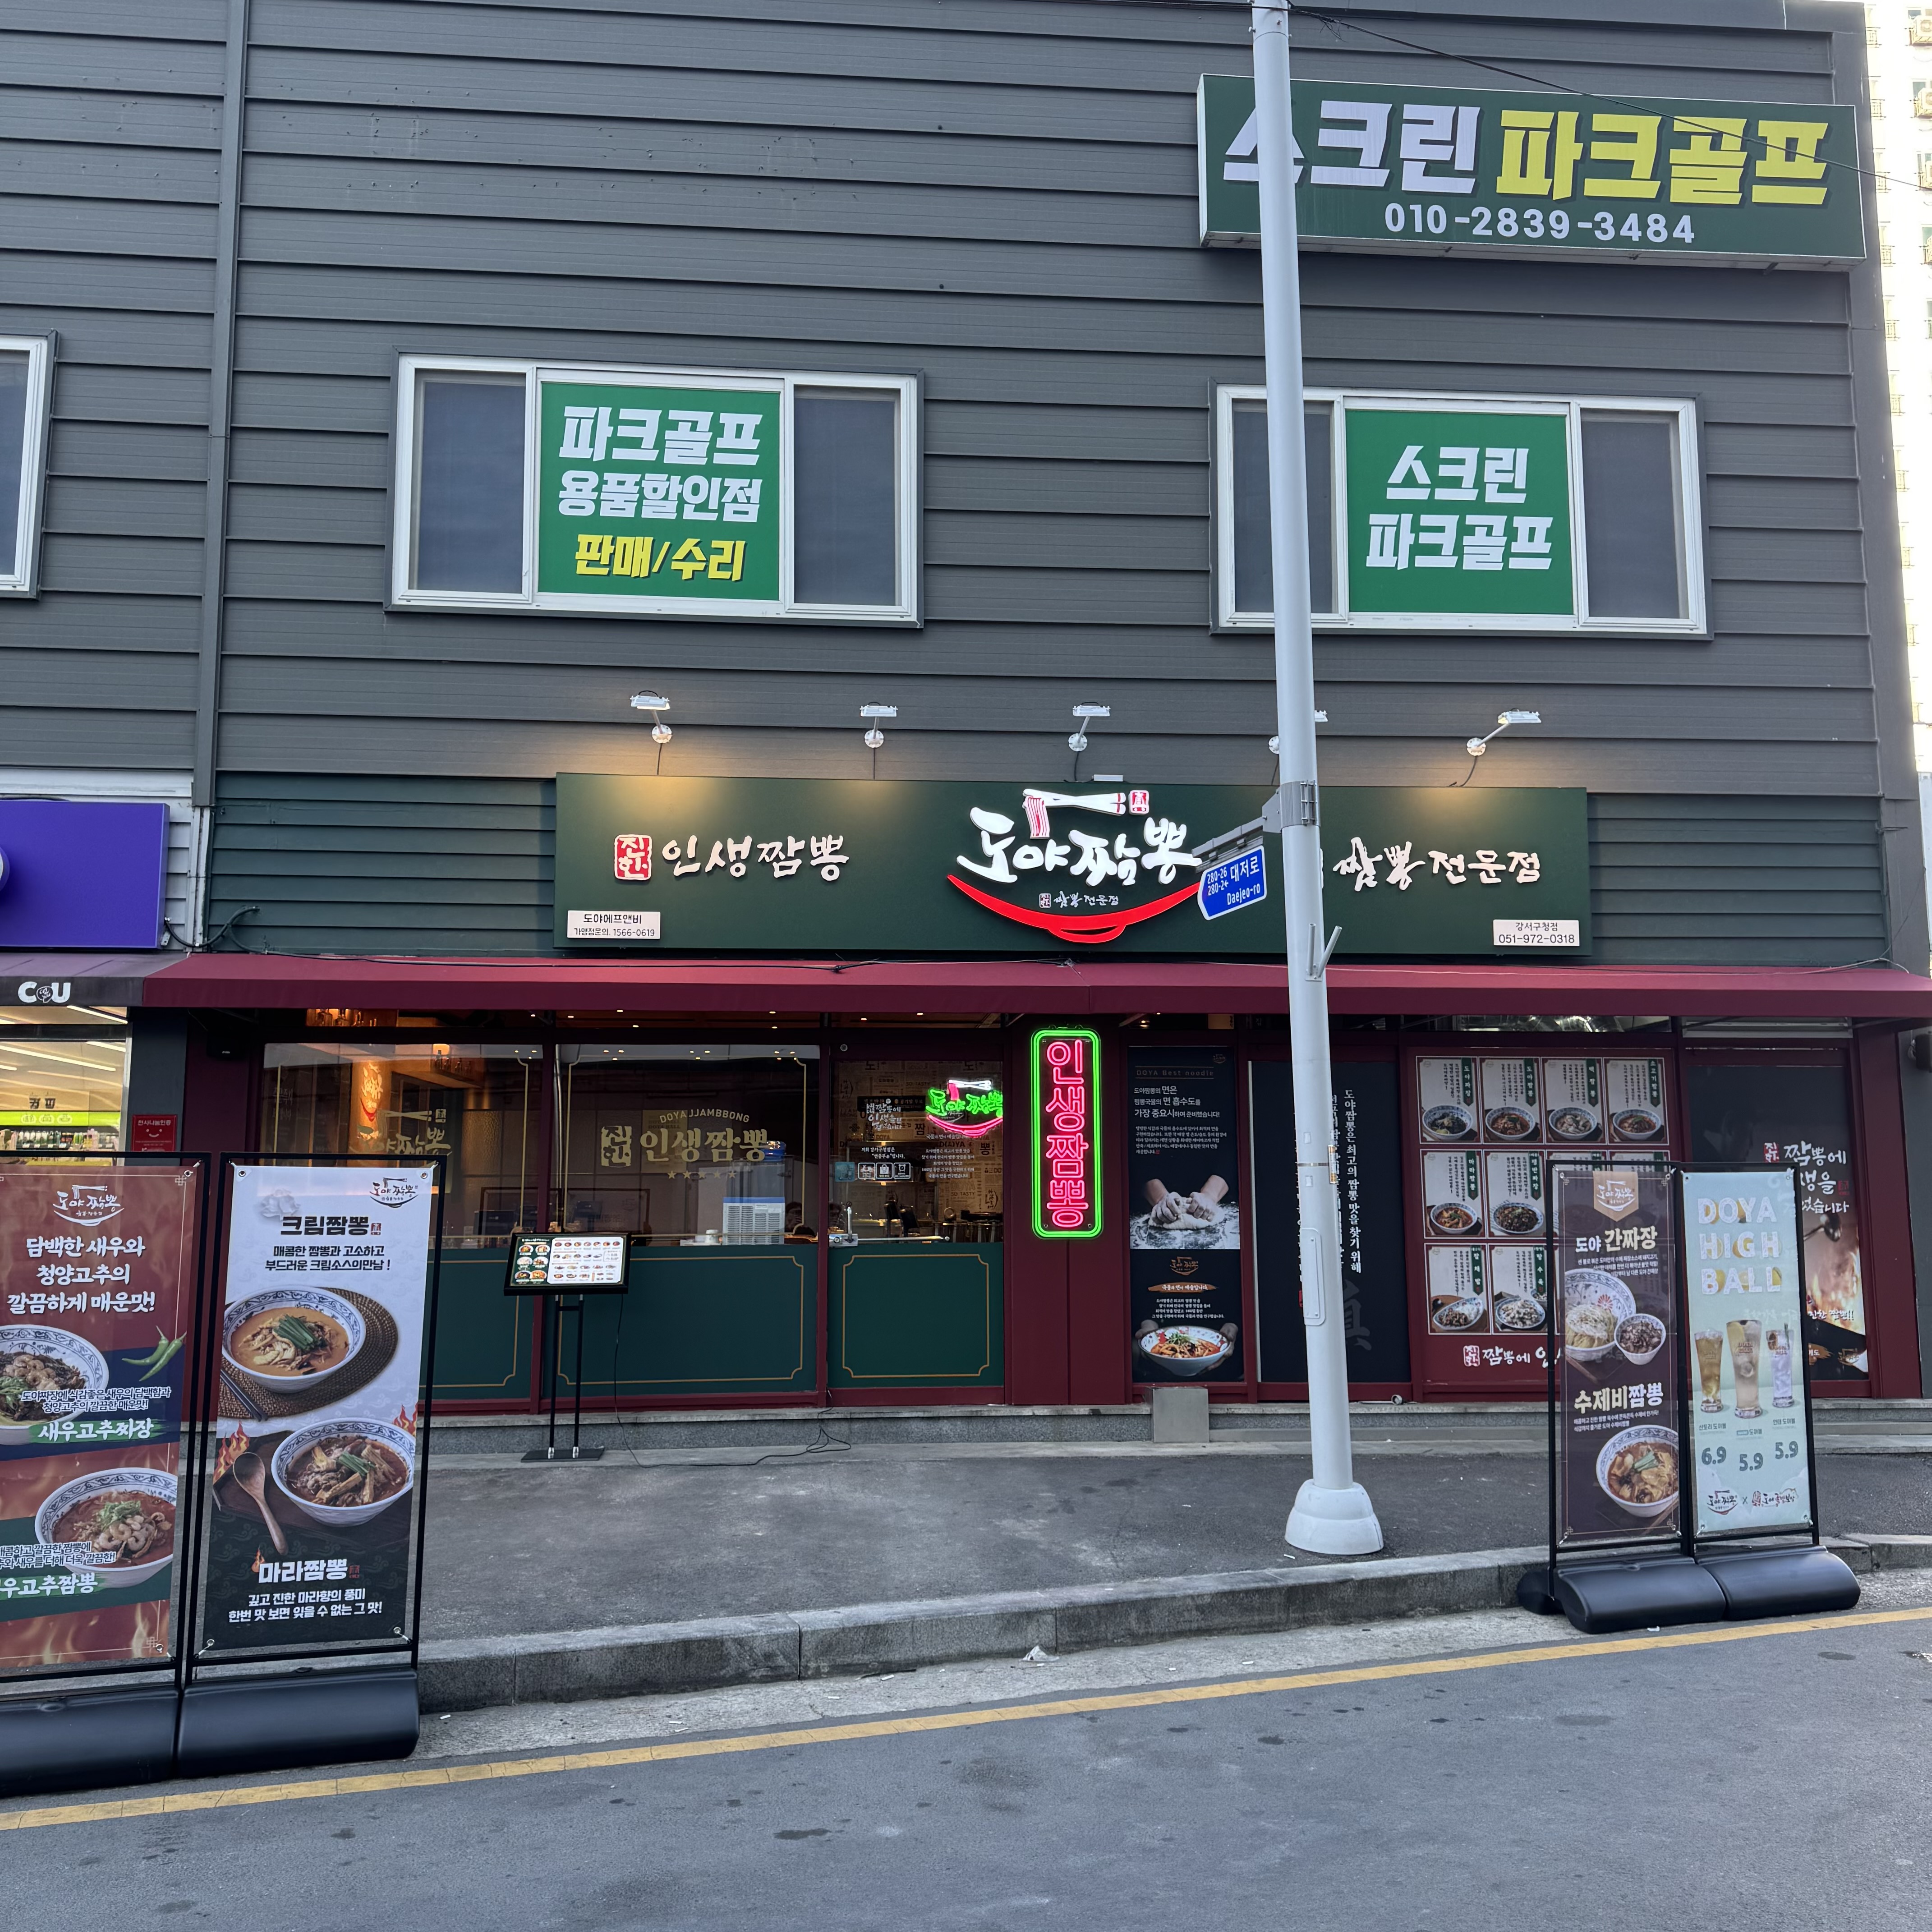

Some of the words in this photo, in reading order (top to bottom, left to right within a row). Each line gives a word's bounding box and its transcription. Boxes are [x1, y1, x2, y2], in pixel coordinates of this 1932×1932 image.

[1224, 100, 1481, 194] 스크린
[1496, 109, 1829, 205] 파크골프
[1385, 202, 1696, 244] 010-2839-3484
[559, 406, 763, 465] 파크골프
[1386, 445, 1529, 503] 스크린
[559, 470, 763, 523] 용품할인점
[1366, 514, 1553, 570] 파크골프
[575, 534, 746, 581] 판매/수리
[614, 834, 652, 880] 진한
[662, 834, 849, 881] 인생짬뽕
[1230, 856, 1260, 882] 대저로
[1207, 866, 1227, 884] 280-26
[1227, 883, 1260, 906] Daejeo-ro
[583, 913, 642, 925] 도야에프앤비
[1515, 922, 1558, 932] 강서구청점
[612, 927, 655, 937] 1566-0619
[1498, 934, 1575, 944] 051-972-0318
[1162, 1086, 1178, 1095] 면은
[1163, 1097, 1171, 1106] 면
[29, 1097, 55, 1110] 커피
[1134, 1109, 1150, 1118] 가장
[1151, 1109, 1186, 1118] 중요시하여
[659, 1110, 686, 1124] DOYA
[688, 1109, 750, 1123] JJAMBBONG
[1344, 1090, 1357, 1143] 도야짬뽕은
[1045, 1040, 1089, 1228] 인생짬뽕
[601, 1126, 632, 1167] 진한
[640, 1128, 767, 1162] 인생짬뽕
[1784, 1141, 1846, 1166] 짬뽕에
[1346, 1144, 1357, 1178] 최고의
[1348, 1179, 1360, 1201] 짬뽕
[1348, 1202, 1360, 1225] 맛을
[1698, 1197, 1777, 1224] DOYA
[281, 1216, 369, 1236] 크림짬뽕
[1349, 1226, 1361, 1249] 찾기
[26, 1236, 84, 1258] 담백한
[86, 1235, 146, 1257] 새우와
[1575, 1235, 1601, 1252] 도야
[1604, 1225, 1658, 1252] 간짜장
[1699, 1231, 1780, 1260] HIGH
[273, 1246, 307, 1257] 매콤한
[308, 1246, 341, 1257] 짬뽕과
[342, 1246, 385, 1257] 고소하고
[1350, 1250, 1362, 1274] 위해
[36, 1264, 130, 1286] 청양고추의
[265, 1260, 308, 1271] 부드러운
[1701, 1266, 1781, 1295] BALL
[7, 1291, 87, 1314] 깔끔하게
[1482, 1346, 1530, 1366] 짬뽕에
[21, 1390, 68, 1402] 도야짜장에
[68, 1389, 106, 1401] 식감좋은
[106, 1388, 135, 1400] 새우의
[134, 1386, 171, 1398] 담백함과
[42, 1401, 90, 1413] 청양고추의
[90, 1400, 118, 1412] 깔끔한
[118, 1398, 149, 1411] 매운맛!
[1573, 1382, 1664, 1414] 수제비짬뽕
[38, 1417, 155, 1442] 새우고추짜장
[1701, 1446, 1727, 1465] 6.9
[1739, 1452, 1764, 1472] 5.9
[1775, 1441, 1799, 1460] 5.9
[33, 1543, 63, 1555] 깔끔한
[63, 1541, 92, 1554] 짬뽕에
[16, 1555, 45, 1569] 새우를
[45, 1554, 64, 1567] 더해
[65, 1553, 85, 1565] 더욱
[85, 1551, 117, 1564] 깔끔한!
[258, 1559, 348, 1583] 마라짬뽕
[0, 1572, 98, 1598] 우고추짬뽕
[248, 1594, 271, 1607] 깊고
[272, 1592, 296, 1605] 진한
[298, 1589, 342, 1604] 마라향의
[344, 1588, 366, 1601] 풍미
[229, 1610, 251, 1624] 한번
[254, 1609, 266, 1622] 맛
[267, 1608, 290, 1621] 보면
[293, 1606, 315, 1619] 잊을
[317, 1605, 329, 1617] 수
[330, 1604, 353, 1617] 없는
[353, 1602, 366, 1614] 그
[367, 1601, 383, 1614] 맛!
